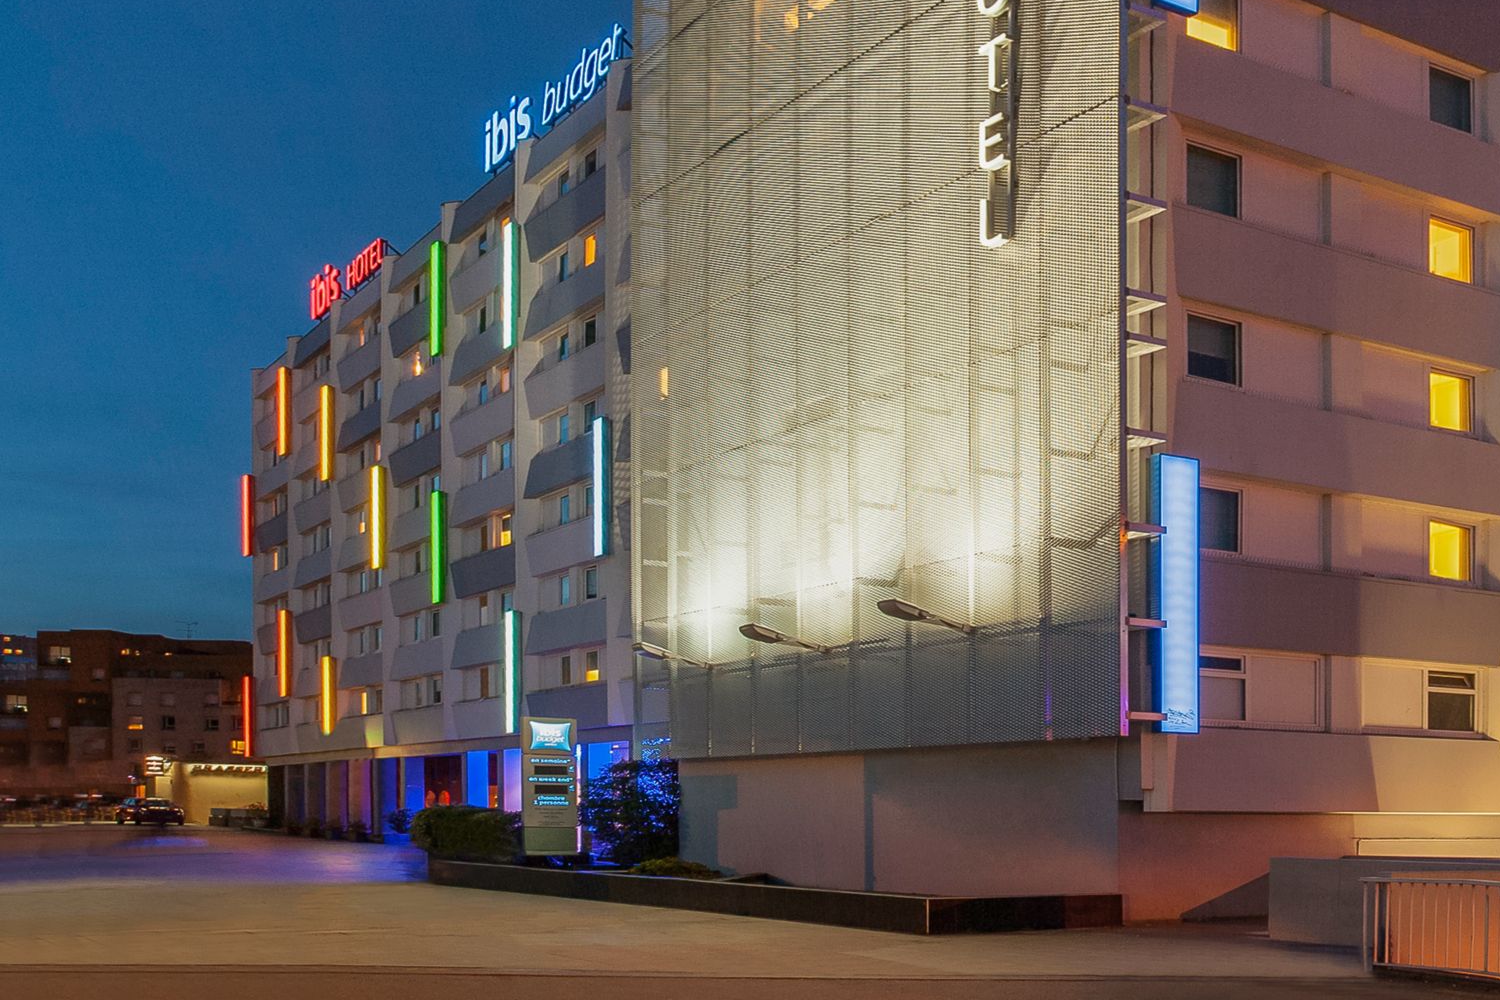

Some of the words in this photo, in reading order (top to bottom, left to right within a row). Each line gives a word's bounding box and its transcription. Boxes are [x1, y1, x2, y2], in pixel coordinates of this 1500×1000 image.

[484, 95, 531, 173] ibis
[541, 23, 622, 126] budget
[309, 264, 342, 321] ibis
[346, 237, 384, 291] HOTEL
